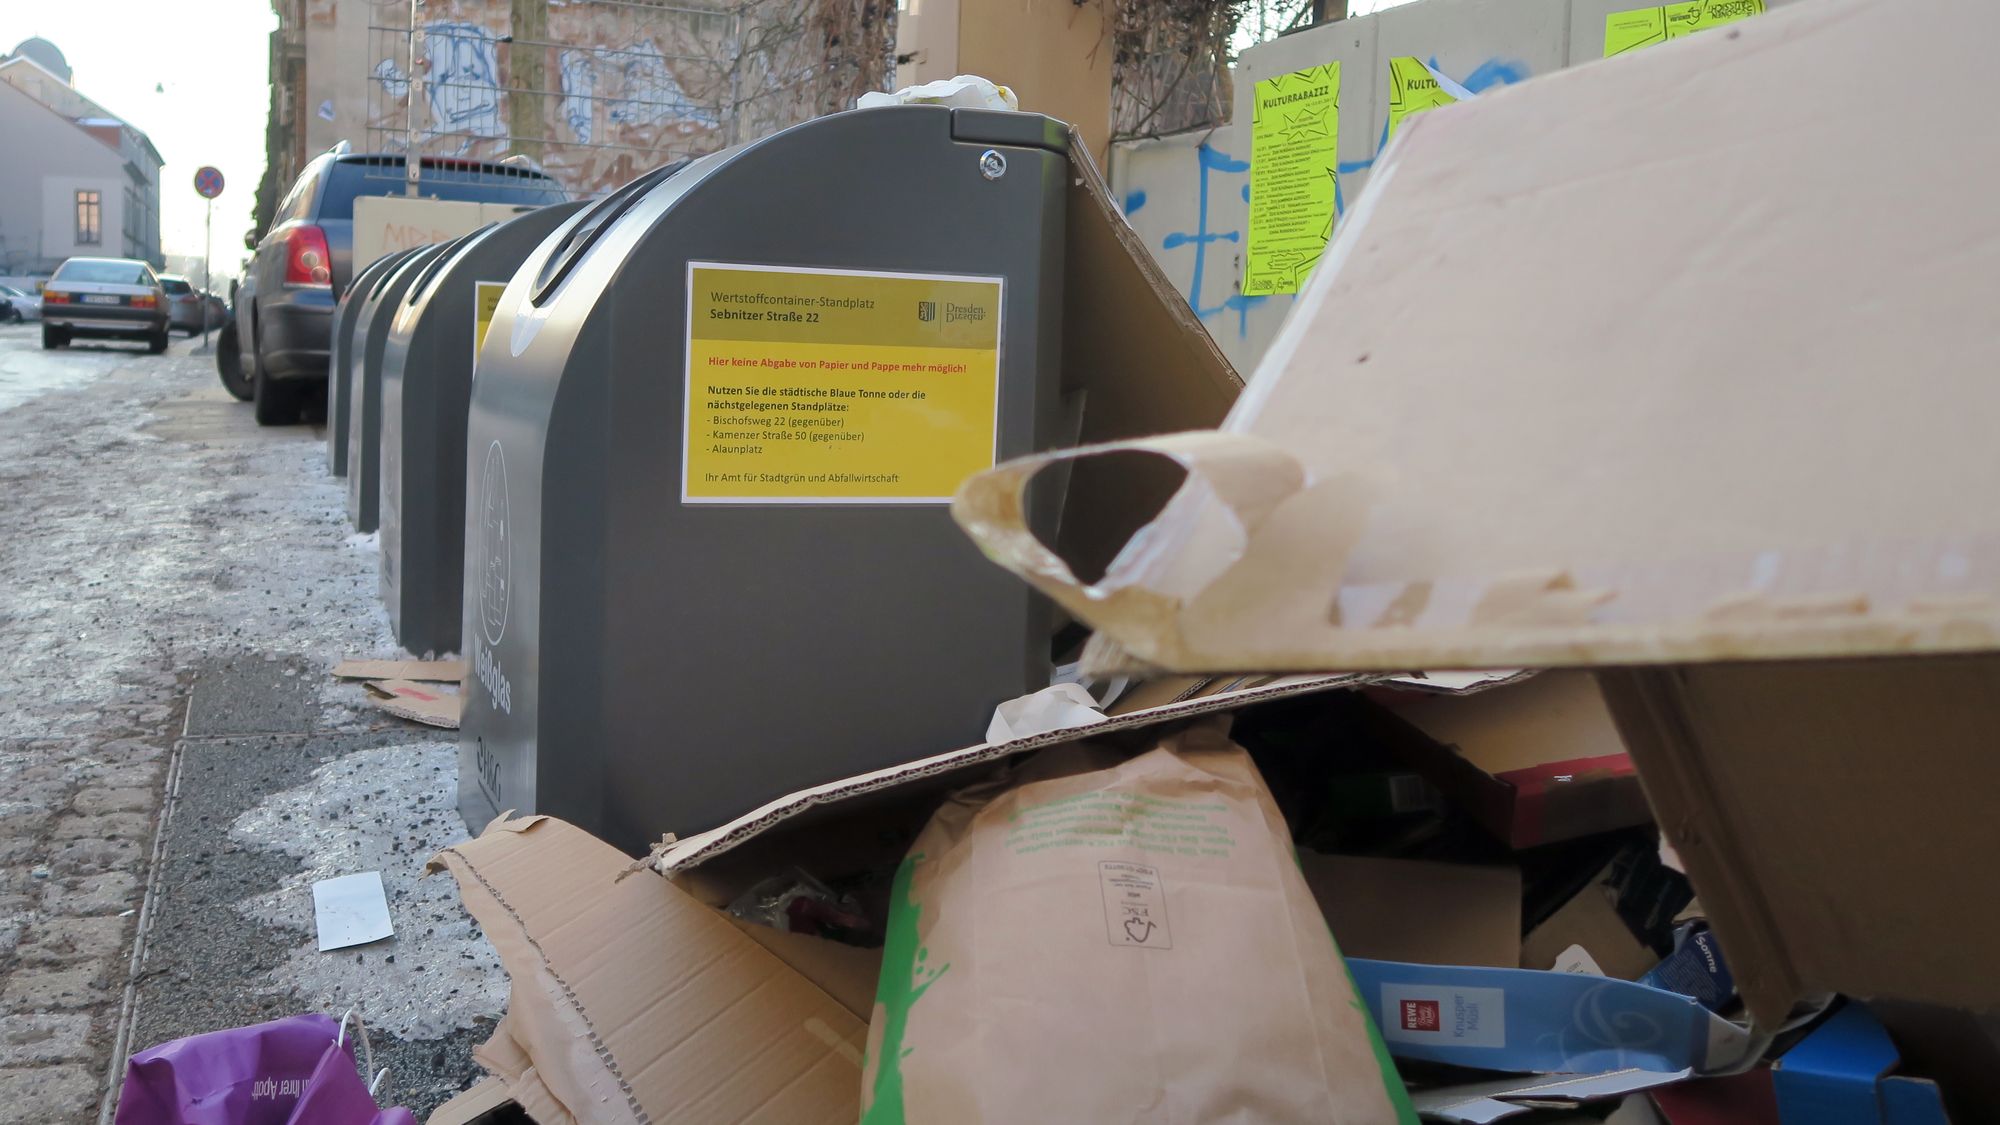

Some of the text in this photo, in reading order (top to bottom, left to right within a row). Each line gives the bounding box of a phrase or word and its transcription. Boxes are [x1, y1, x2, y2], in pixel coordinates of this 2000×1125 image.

[1407, 79, 1440, 90] KULTU
[1263, 85, 1329, 109] KULTURRABAZZZ
[710, 291, 875, 310] Wertstoffcontainer-Standplatz
[710, 309, 819, 323] Sebnitzer Straße 22
[708, 357, 967, 374] Hier keine Abgabe von Papier und Pappe mehr möglich!
[707, 386, 926, 400] Nutzen Sie die städtische Blaue Tonne oder die
[707, 400, 849, 413] nächstgelegenen Standplätze:
[713, 415, 772, 427] Bischofsweg
[774, 417, 786, 426] 22
[788, 417, 844, 428] (gegenüber)
[713, 430, 760, 440] Kamenzer
[762, 431, 793, 440] Straße
[795, 432, 807, 440] 50
[809, 431, 865, 442] (gegenüber)
[712, 444, 763, 455] Alaunplatz
[705, 473, 899, 484] Ihr Amt für Stadtgrün und Abfallwirtschaft
[474, 633, 511, 715] Weißglas
[1695, 936, 1717, 973] Sonne
[1406, 1002, 1417, 1029] REWE
[1454, 994, 1466, 1037] Knusper
[1466, 1003, 1479, 1031] Müsli
